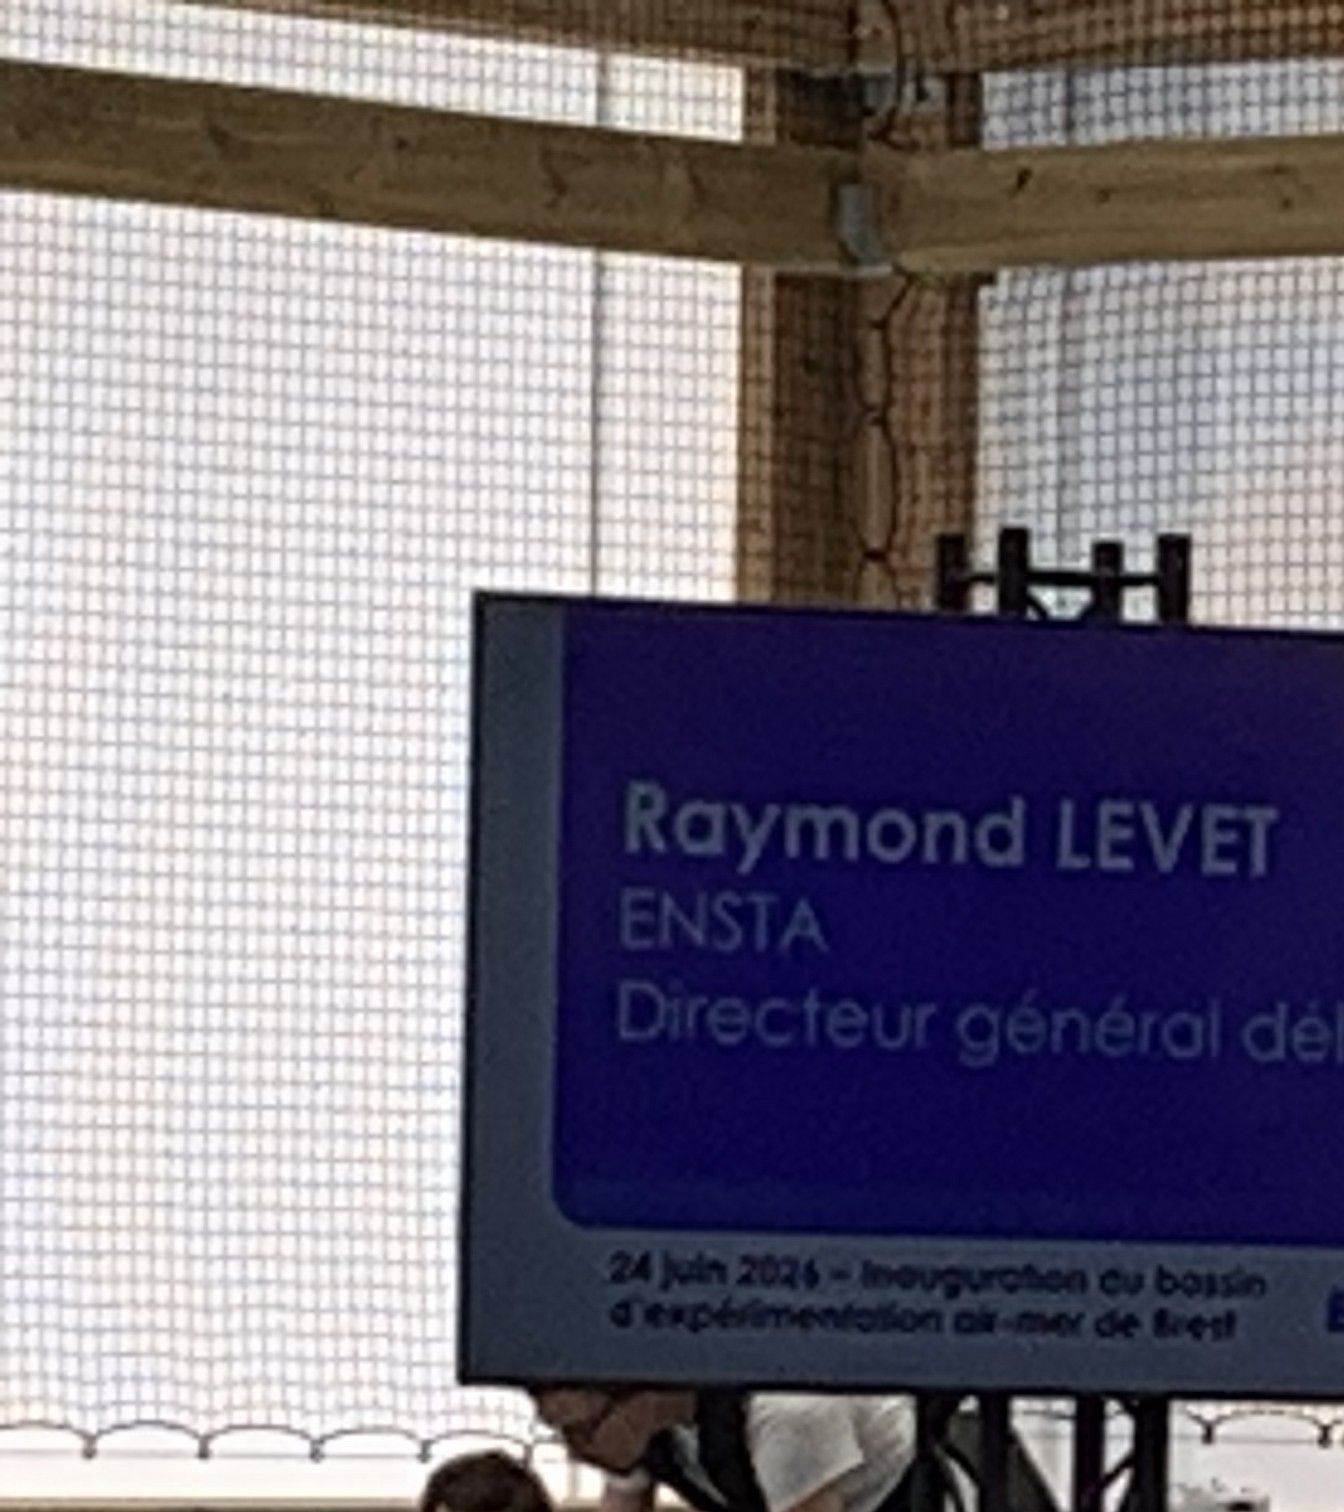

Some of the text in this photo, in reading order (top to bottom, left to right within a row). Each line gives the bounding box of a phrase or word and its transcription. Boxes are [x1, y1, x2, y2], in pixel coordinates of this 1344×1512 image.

[624, 781, 1279, 879] Raymond LEVET
[618, 889, 828, 953] ENSTA
[615, 980, 936, 1051] Directeur
[956, 986, 1222, 1069] général
[606, 1249, 651, 1284] 24
[660, 1249, 728, 1291] juin
[737, 1254, 821, 1290] 2026
[861, 1258, 1089, 1300] Inauguration
[1098, 1265, 1144, 1296] du
[1155, 1264, 1268, 1299] bassin
[1094, 1307, 1141, 1339] de
